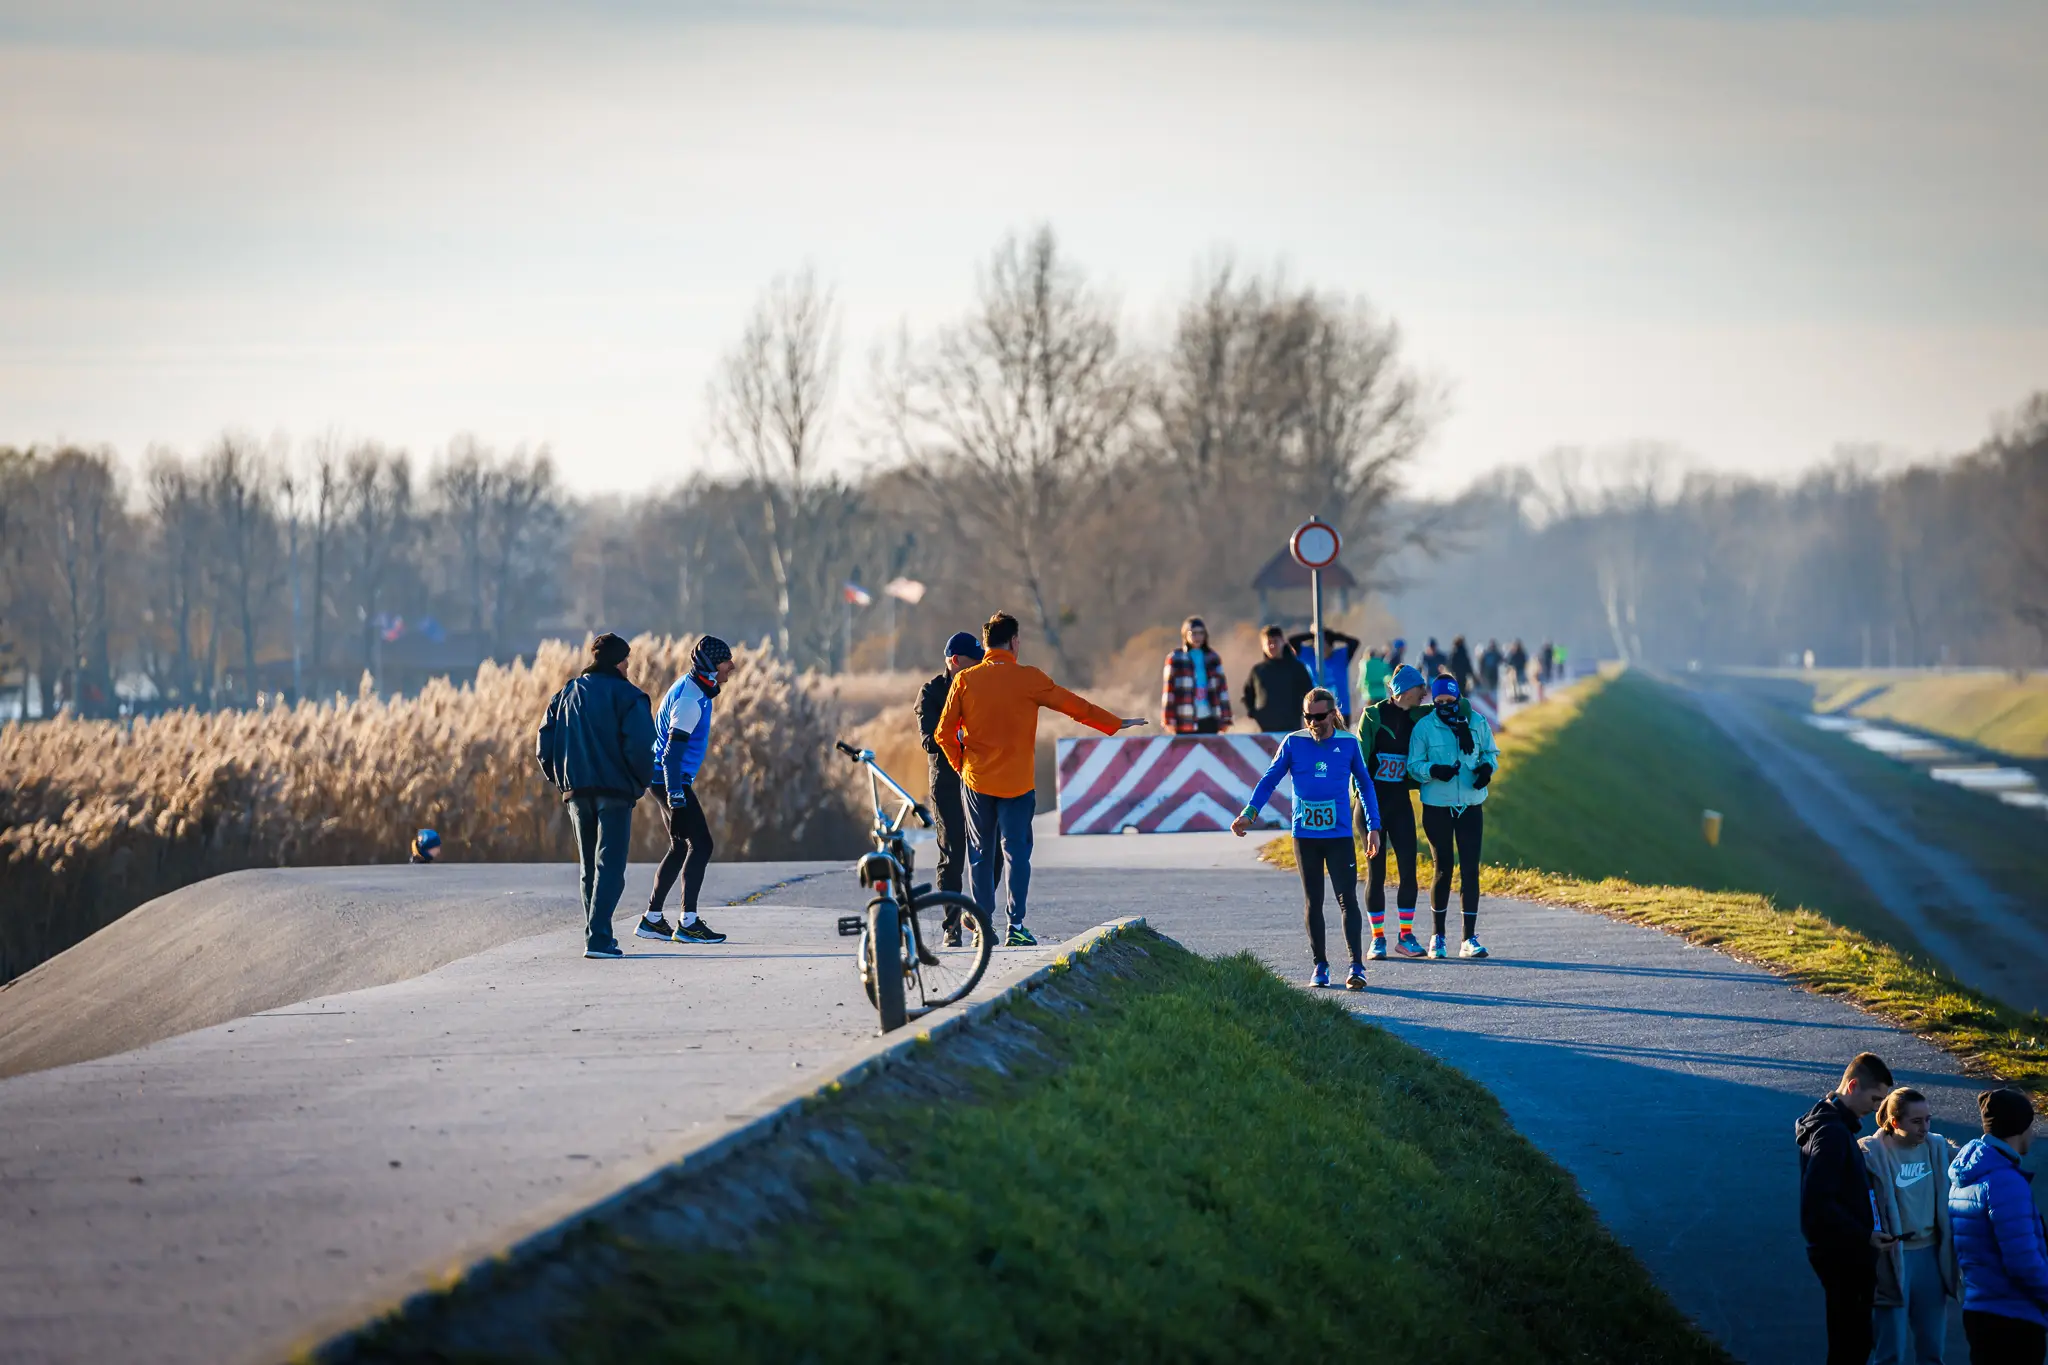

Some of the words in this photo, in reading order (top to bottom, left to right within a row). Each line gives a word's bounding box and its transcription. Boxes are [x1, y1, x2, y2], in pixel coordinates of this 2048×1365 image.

[1378, 759, 1405, 778] 292
[1304, 807, 1334, 827] 263
[1900, 1162, 1926, 1177] NIKE
